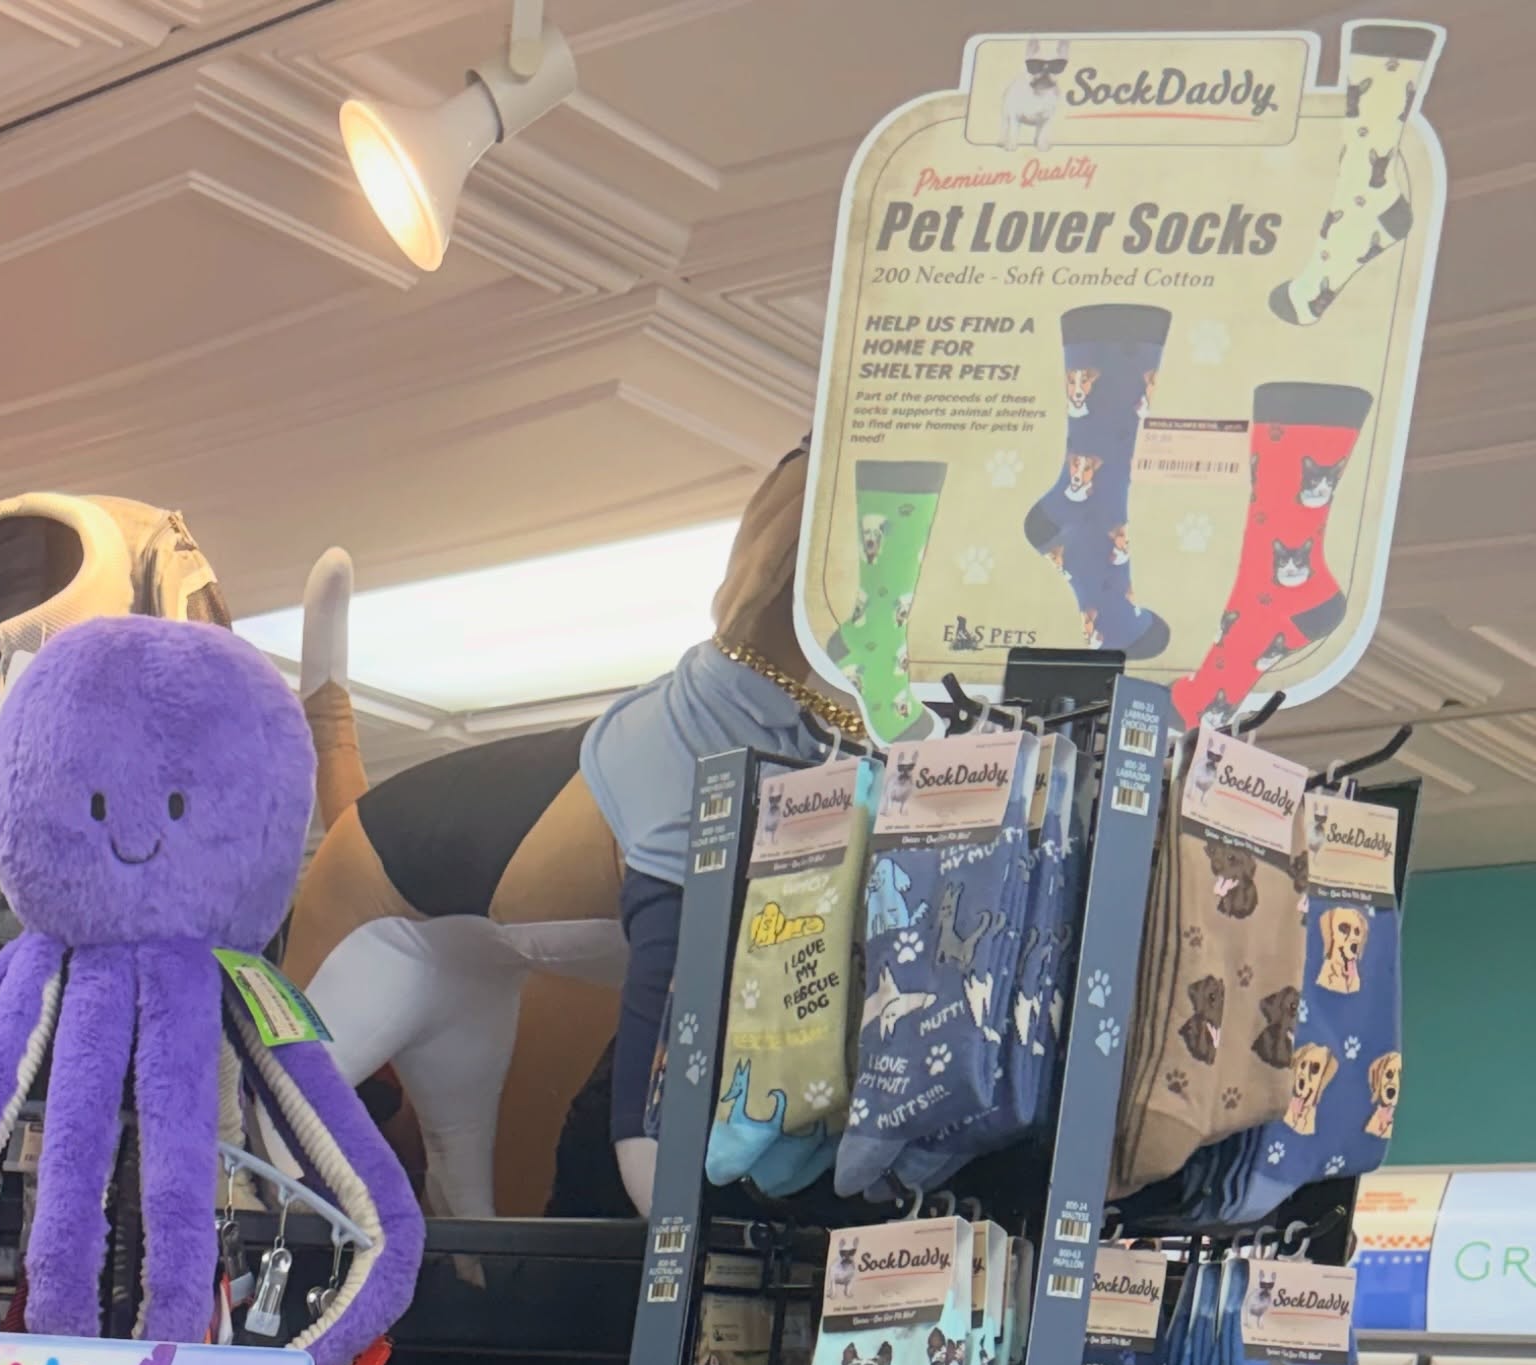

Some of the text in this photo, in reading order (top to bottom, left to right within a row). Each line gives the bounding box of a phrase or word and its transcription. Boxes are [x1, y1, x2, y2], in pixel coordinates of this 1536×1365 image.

[1065, 66, 1279, 116] SockDaddy
[913, 155, 1099, 197] Premium Quality
[875, 201, 1283, 256] Pet Lover Socks
[871, 265, 1216, 288] 200 Needle Soft Combed Cotton
[865, 315, 1035, 333] HELP US FIND A
[862, 339, 975, 356] HOME FOR
[859, 362, 1020, 381] SHELTER PETS!
[853, 405, 1047, 419] socks supports animal shelters
[856, 391, 1036, 406] Part of the proceeds of these
[852, 419, 1034, 434] to find new homes for pets in
[990, 628, 1037, 645] PETS
[916, 753, 1009, 794] SockDaddy
[1219, 762, 1295, 817] SockDaddy
[782, 790, 853, 818] SockDaddy
[1324, 820, 1394, 858] SockDaddy
[791, 938, 827, 972] LOVE
[795, 958, 819, 984] MY
[796, 993, 831, 1020] DOG
[874, 1056, 908, 1074] LOVE
[857, 1243, 952, 1277] SockDaddy
[1272, 1286, 1351, 1316] SockDaddy
